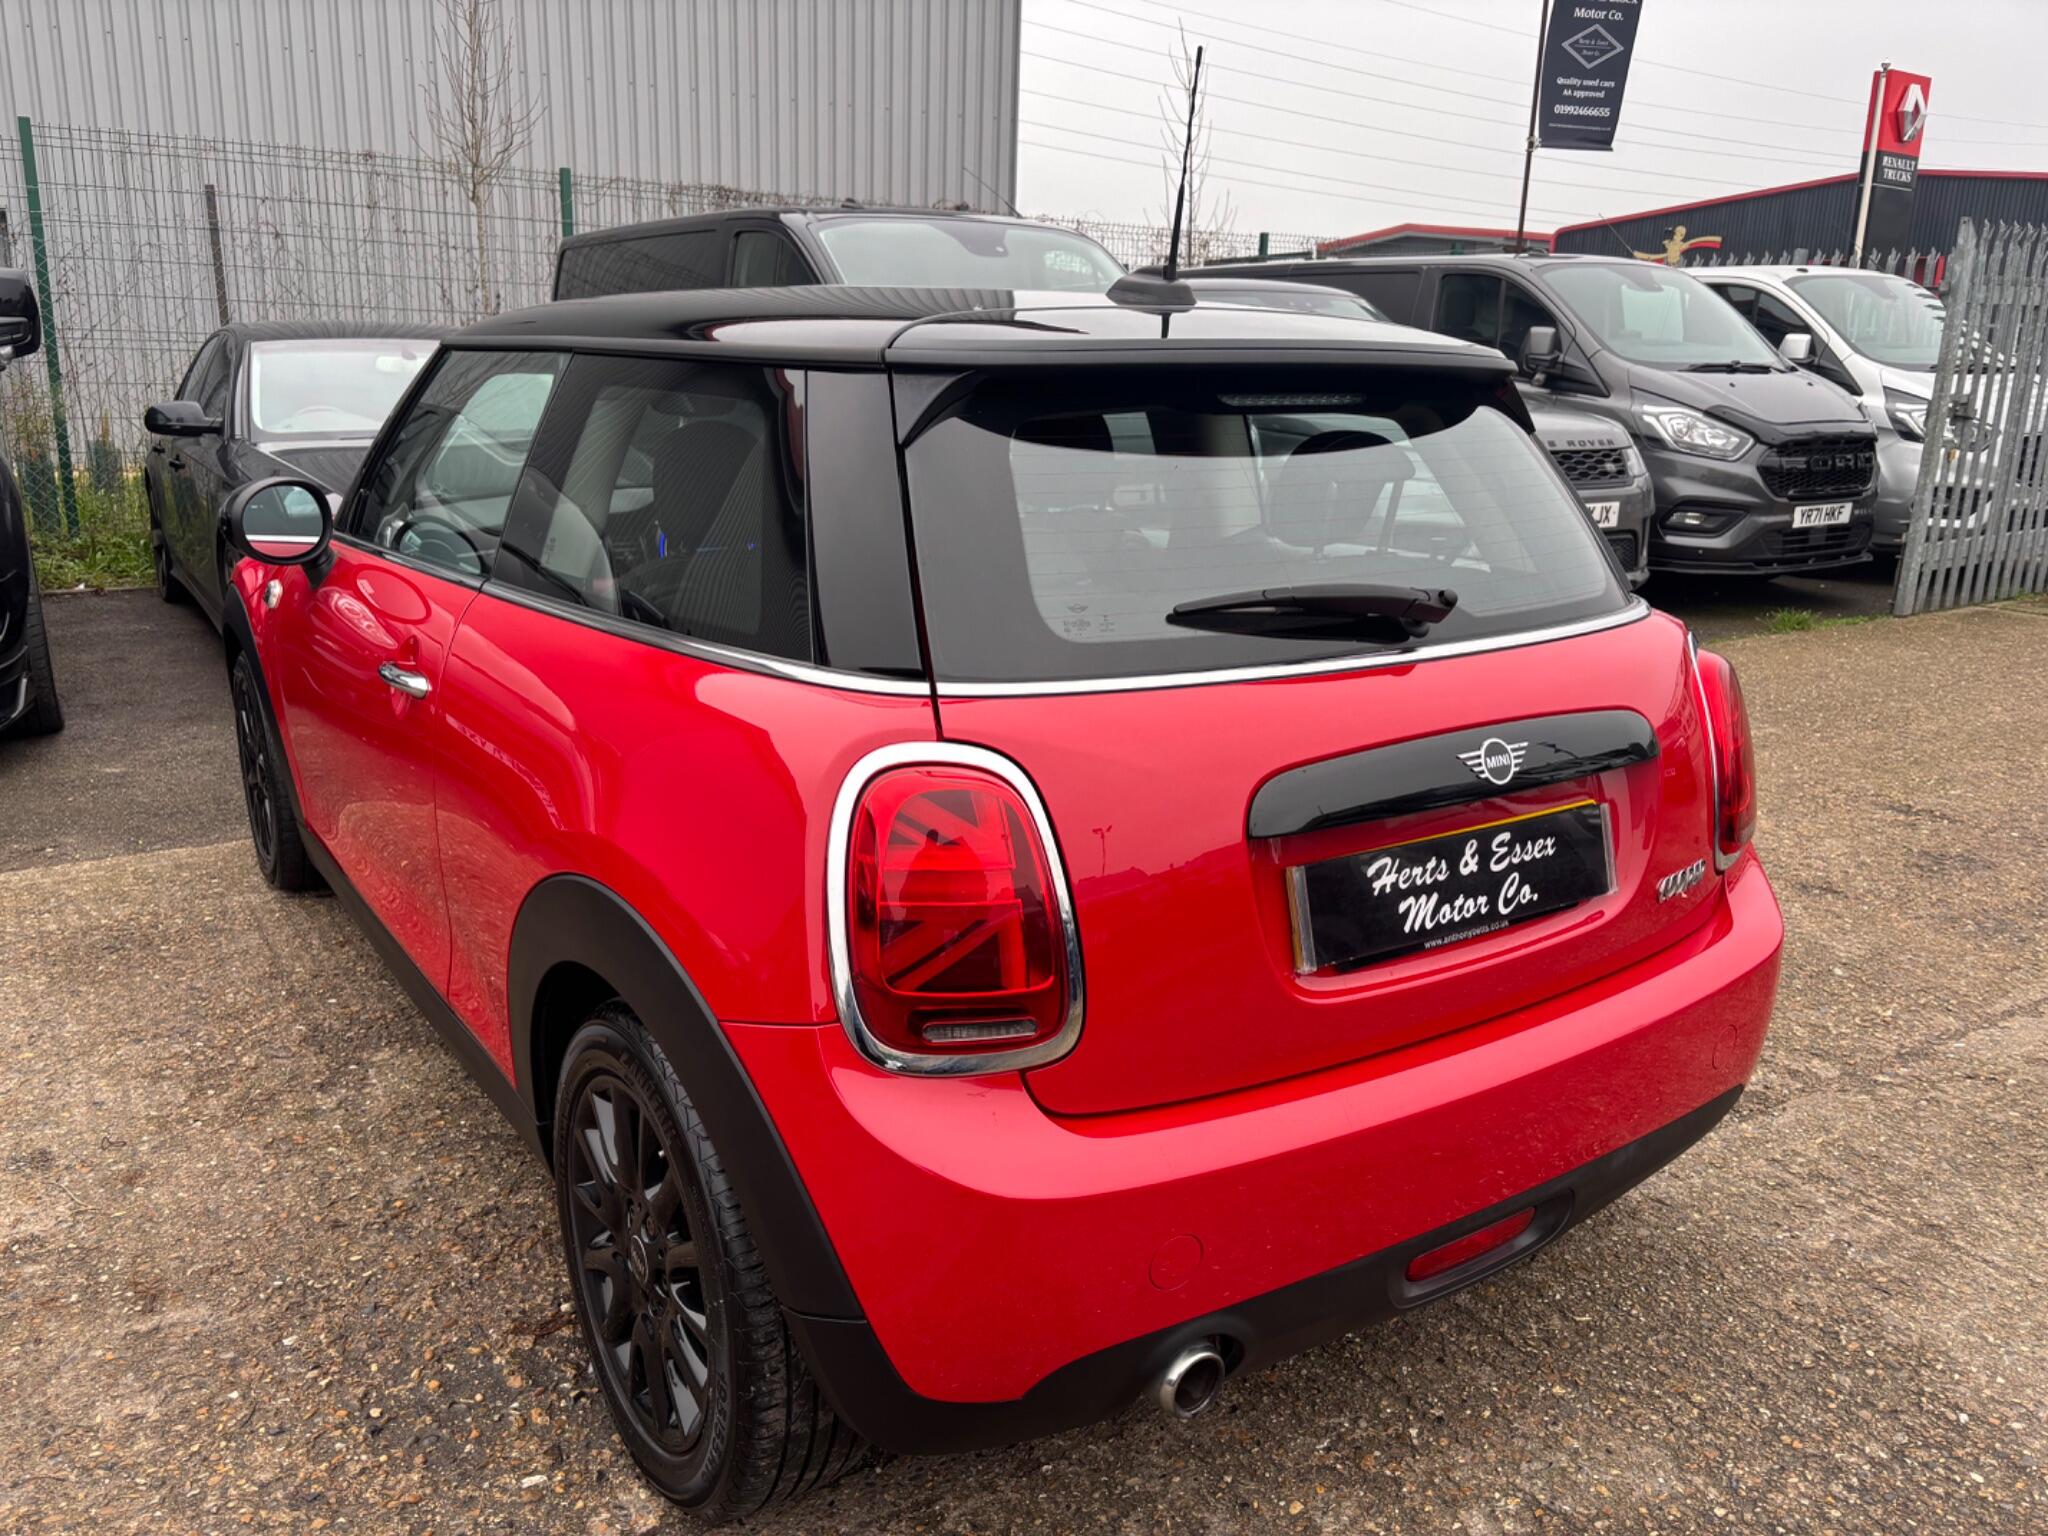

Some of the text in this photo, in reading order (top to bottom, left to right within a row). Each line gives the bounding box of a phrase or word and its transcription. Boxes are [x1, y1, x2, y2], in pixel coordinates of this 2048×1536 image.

[1574, 7, 1624, 21] Motor Co.
[1556, 76, 1616, 88] Quality used cars
[1562, 88, 1605, 98] AA approved
[1882, 156, 1916, 172] RENAULT
[1883, 168, 1912, 182] TRUCKS
[1566, 439, 1615, 447] ROVER
[1800, 505, 1846, 525] YR71 HKF
[1486, 752, 1510, 769] MINI
[1366, 831, 1556, 896] Herts & Essex
[1398, 871, 1538, 934] Motor Co.
